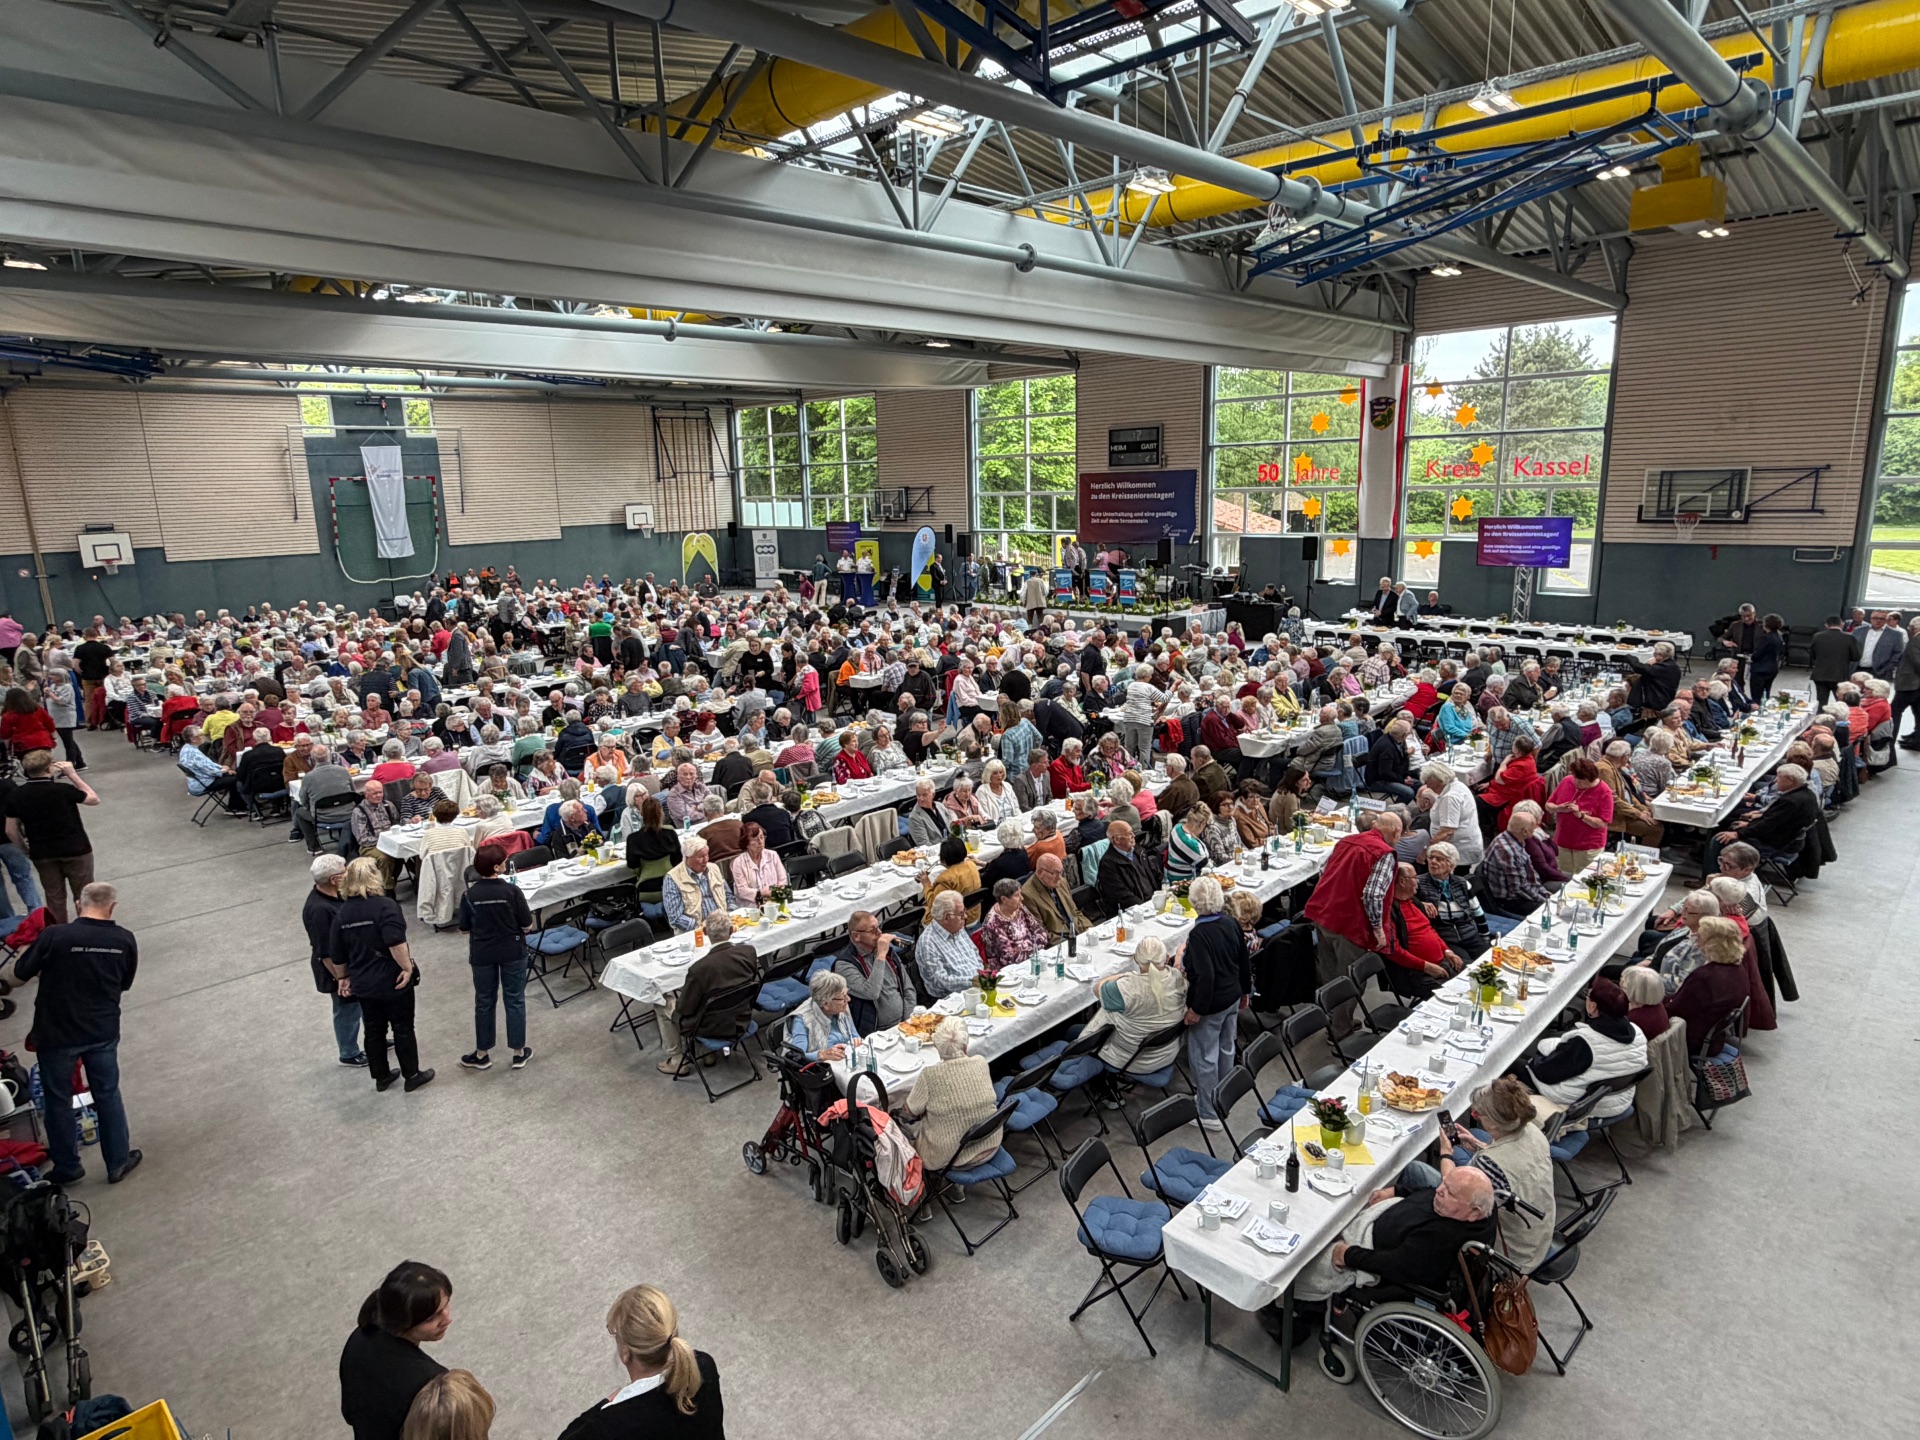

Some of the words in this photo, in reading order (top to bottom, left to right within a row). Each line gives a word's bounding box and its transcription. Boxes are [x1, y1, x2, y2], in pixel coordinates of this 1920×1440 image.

[1257, 463, 1280, 482] 50
[1292, 463, 1341, 486] Jahre
[1425, 458, 1481, 479] Kreis
[1513, 454, 1590, 478] Kassel
[1091, 481, 1115, 490] Herzlich
[1116, 481, 1156, 489] Willkommen
[1098, 492, 1111, 500] den
[1111, 491, 1175, 501] Kreisseniorentagen!
